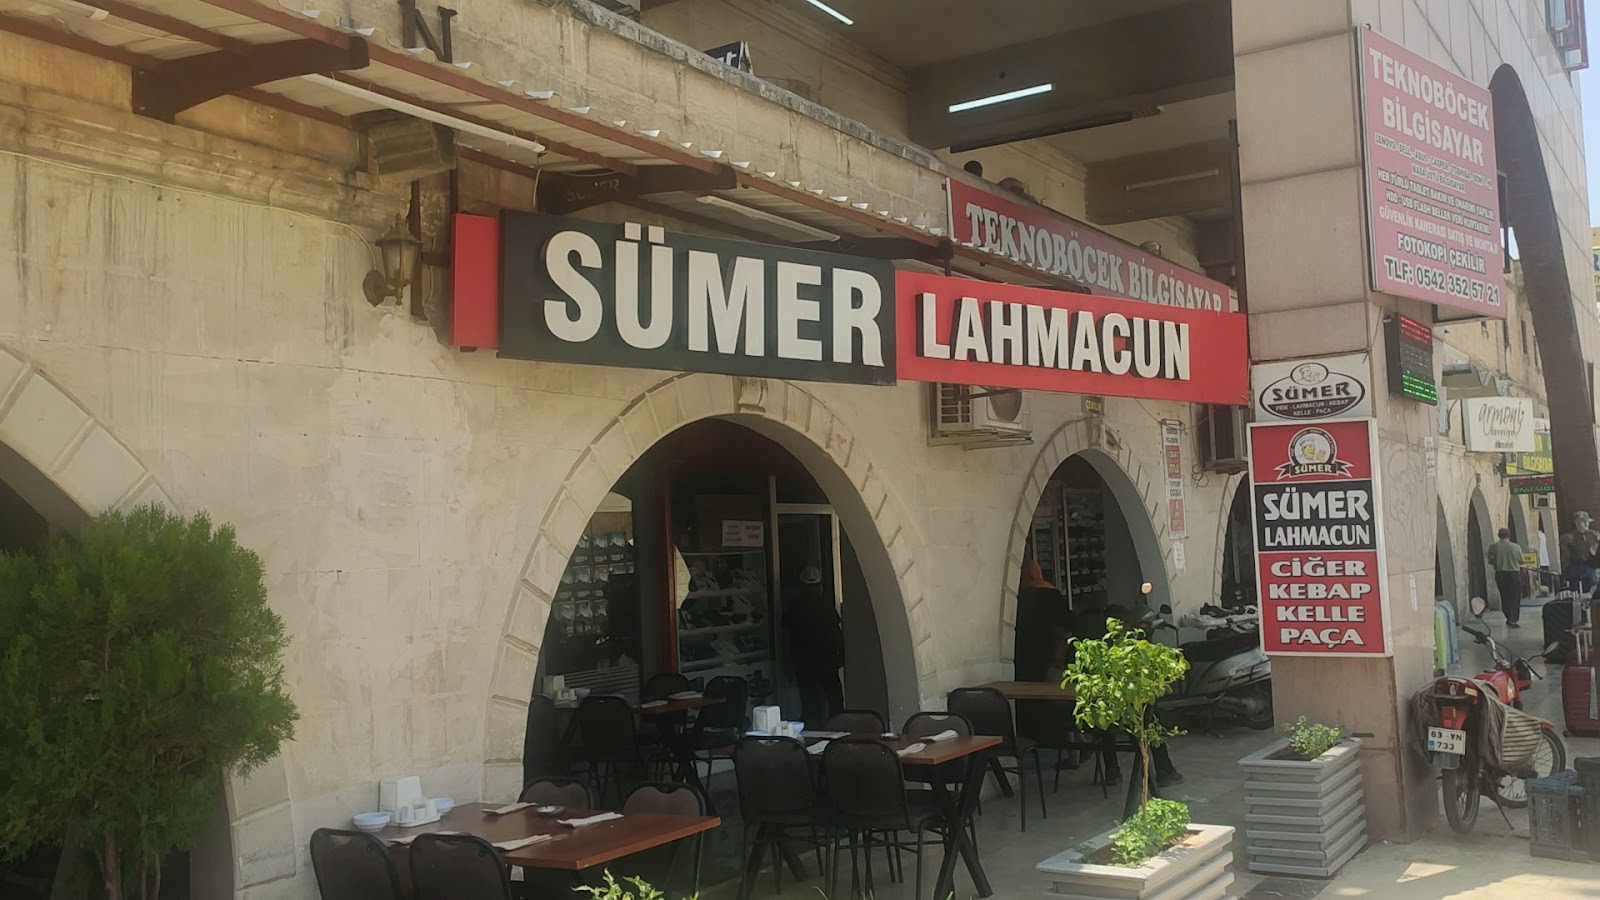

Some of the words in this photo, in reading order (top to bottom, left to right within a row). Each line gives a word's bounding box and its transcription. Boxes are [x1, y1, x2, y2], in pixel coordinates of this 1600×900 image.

[1369, 47, 1489, 131] TEKNOBÖCEK
[1382, 96, 1484, 166] BİLGİSAYAR
[1399, 143, 1412, 158] DELL
[1409, 180, 1430, 199] TABLET
[1401, 194, 1413, 210] USB
[1413, 199, 1431, 216] FLASH
[1431, 205, 1451, 222] BELLEK
[1380, 205, 1413, 229] GÜVENLİK
[1414, 217, 1446, 239] KAMERASI
[1464, 233, 1474, 247] VE
[966, 202, 1124, 294] TEKNOBÖCEK
[1397, 232, 1447, 264] FOTOKOPİ
[1449, 248, 1485, 274] ÇEKİLİR
[1416, 265, 1445, 290] 0542
[1447, 274, 1469, 297] 352
[1470, 280, 1484, 300] 57
[1487, 285, 1499, 305] 21
[543, 221, 885, 367] SÜMER
[920, 291, 1191, 381] LAHMACUN
[1272, 382, 1350, 401] SÜMER
[1293, 402, 1325, 410] LAHMACUN
[1329, 399, 1349, 407] KEBAP
[1294, 463, 1332, 474] SÜMER
[1263, 487, 1370, 521] SÜMER
[1265, 525, 1370, 546] LAHMACUN
[1271, 556, 1366, 577] CİĞER
[1269, 583, 1371, 599] KEBAP
[1276, 605, 1365, 622] KELLE
[1280, 628, 1364, 648] PAÇA
[1437, 742, 1454, 750] 733
